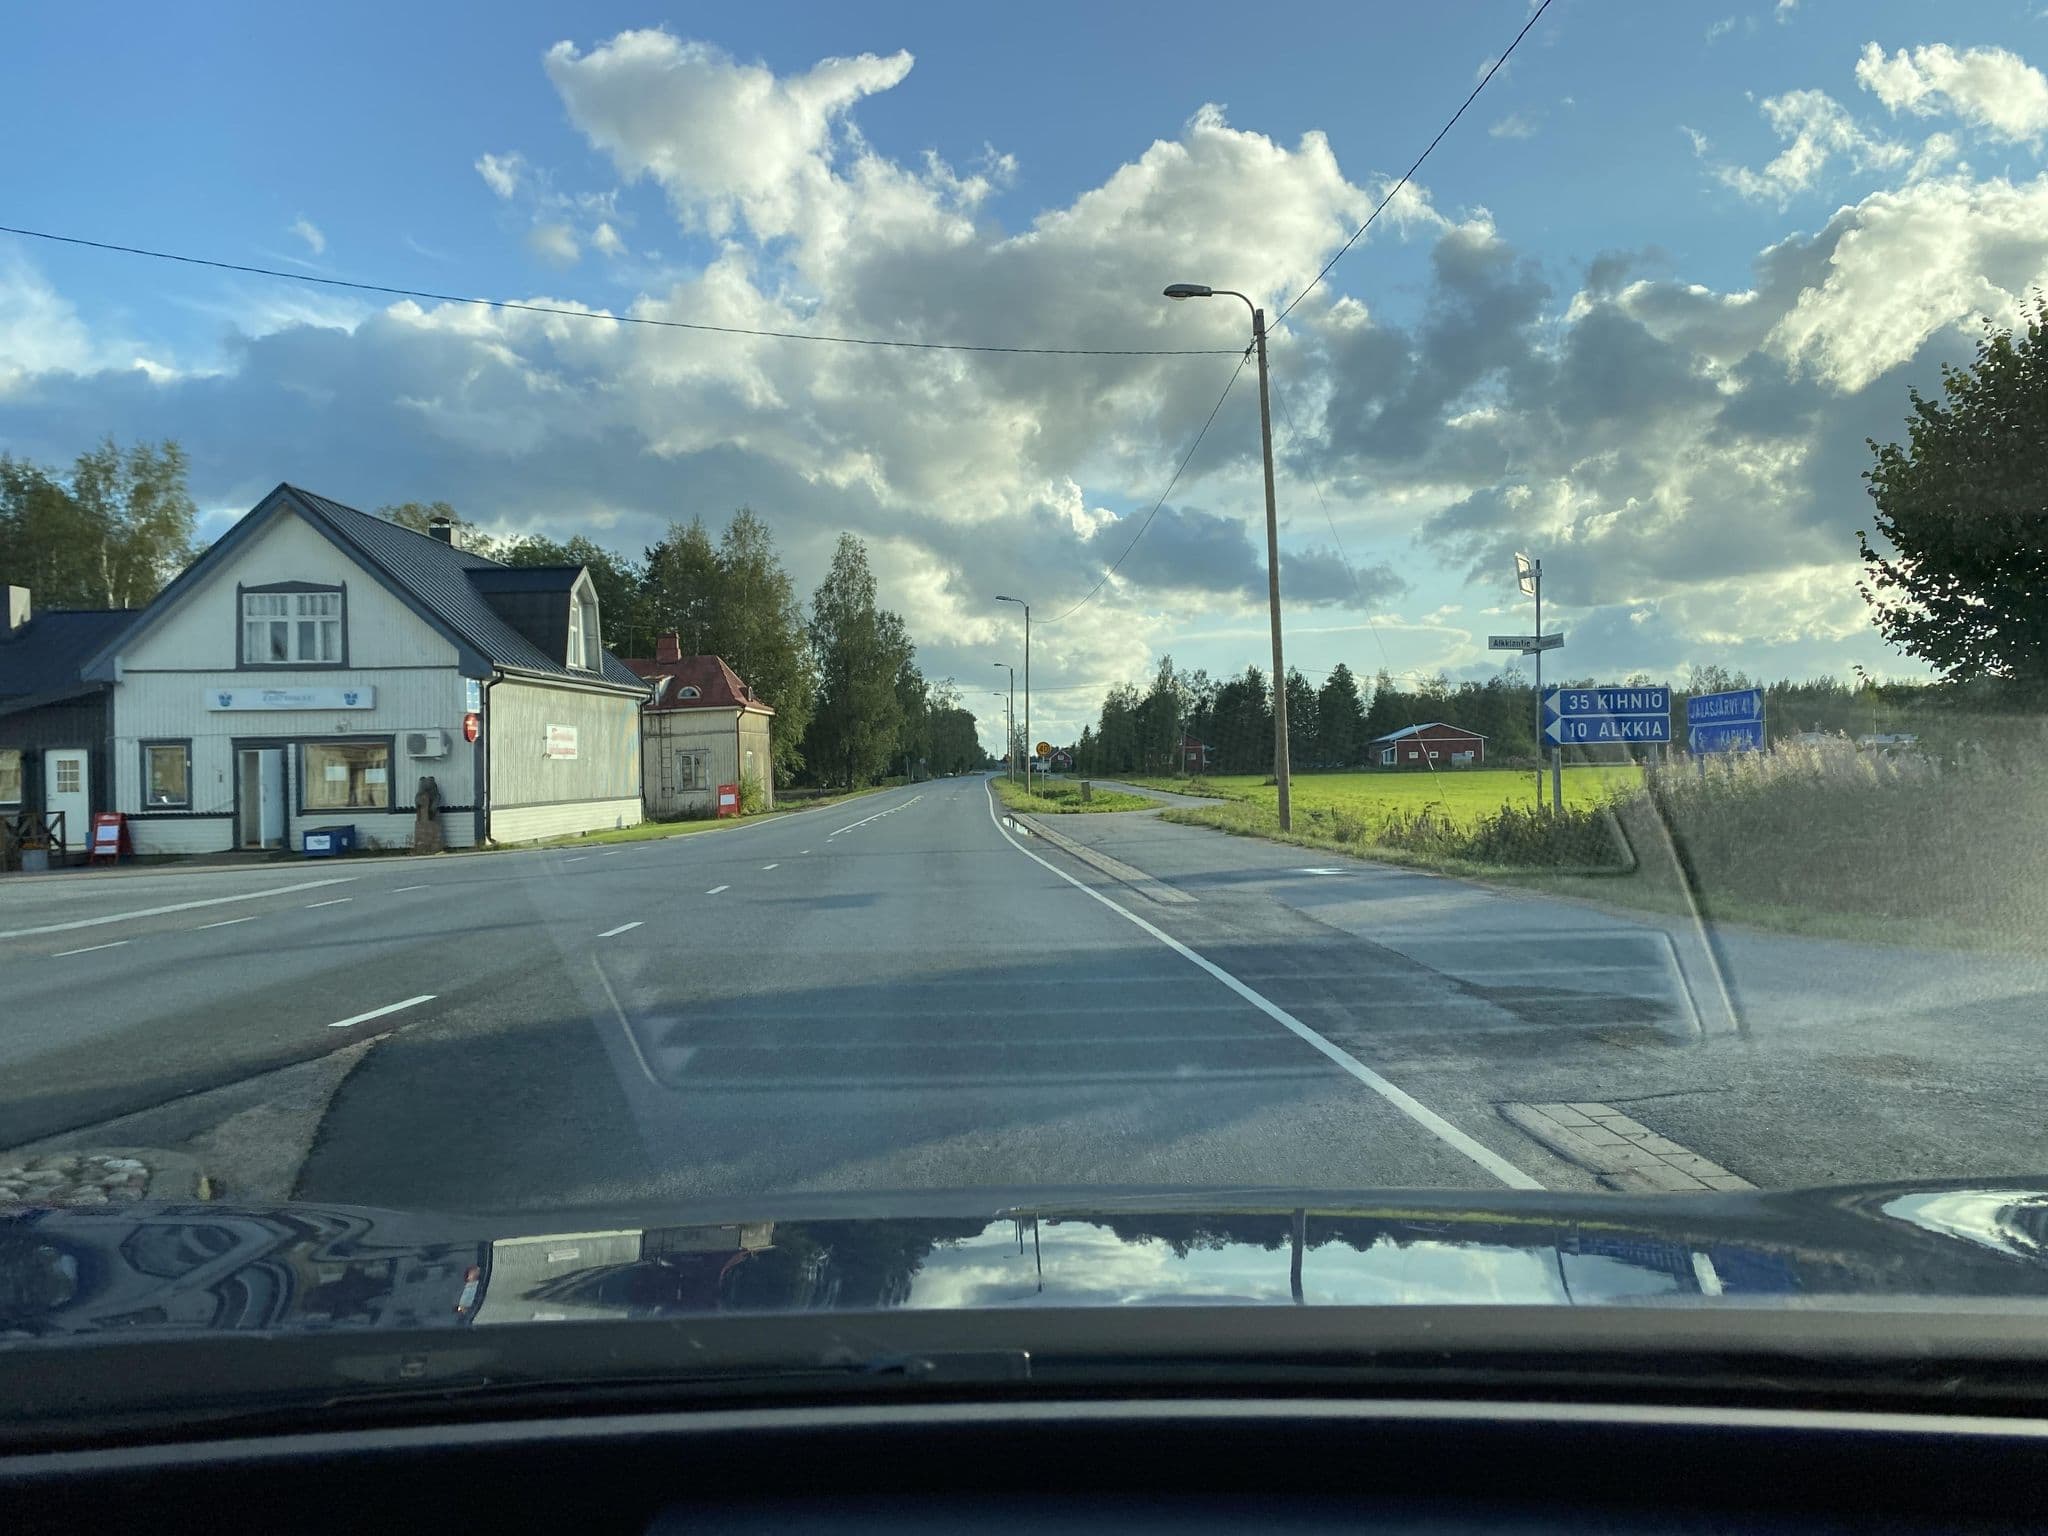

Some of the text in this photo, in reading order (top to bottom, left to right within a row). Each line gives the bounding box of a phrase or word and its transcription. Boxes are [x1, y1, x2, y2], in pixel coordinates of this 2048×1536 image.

[1569, 691, 1663, 710] 35 KIHNIÖ
[1570, 721, 1663, 738] 10 ALKKIA
